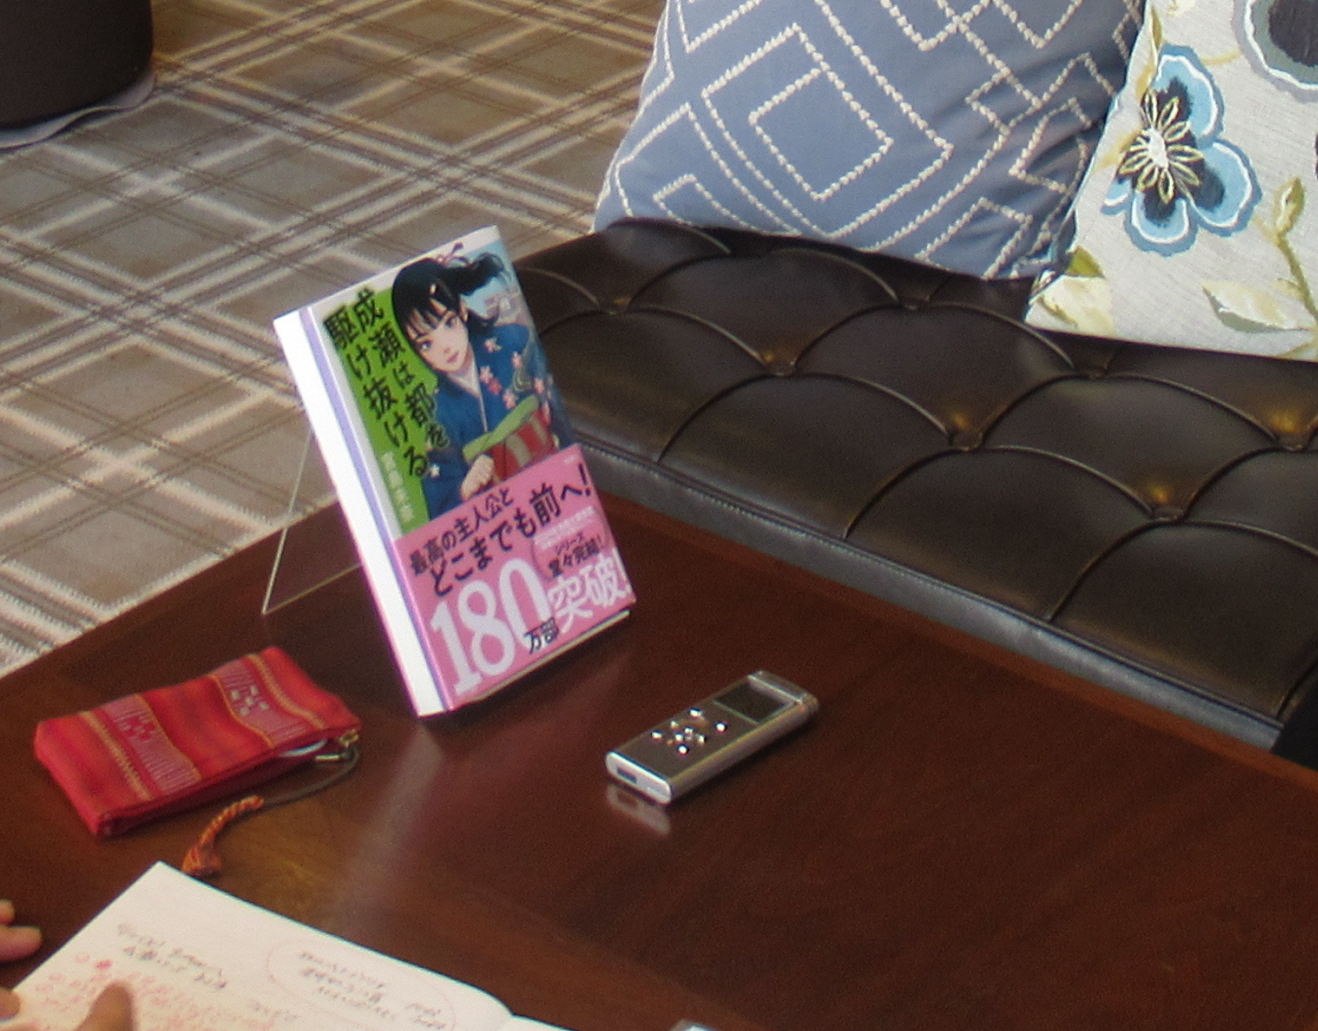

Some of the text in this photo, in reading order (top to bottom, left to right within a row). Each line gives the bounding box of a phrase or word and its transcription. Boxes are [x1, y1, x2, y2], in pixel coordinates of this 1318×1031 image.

[323, 303, 430, 477] 駆け抜ける
[352, 286, 450, 451] 成瀬は都を
[409, 486, 515, 576] 最高の主人公と
[429, 464, 592, 597] どこまでも前へ！
